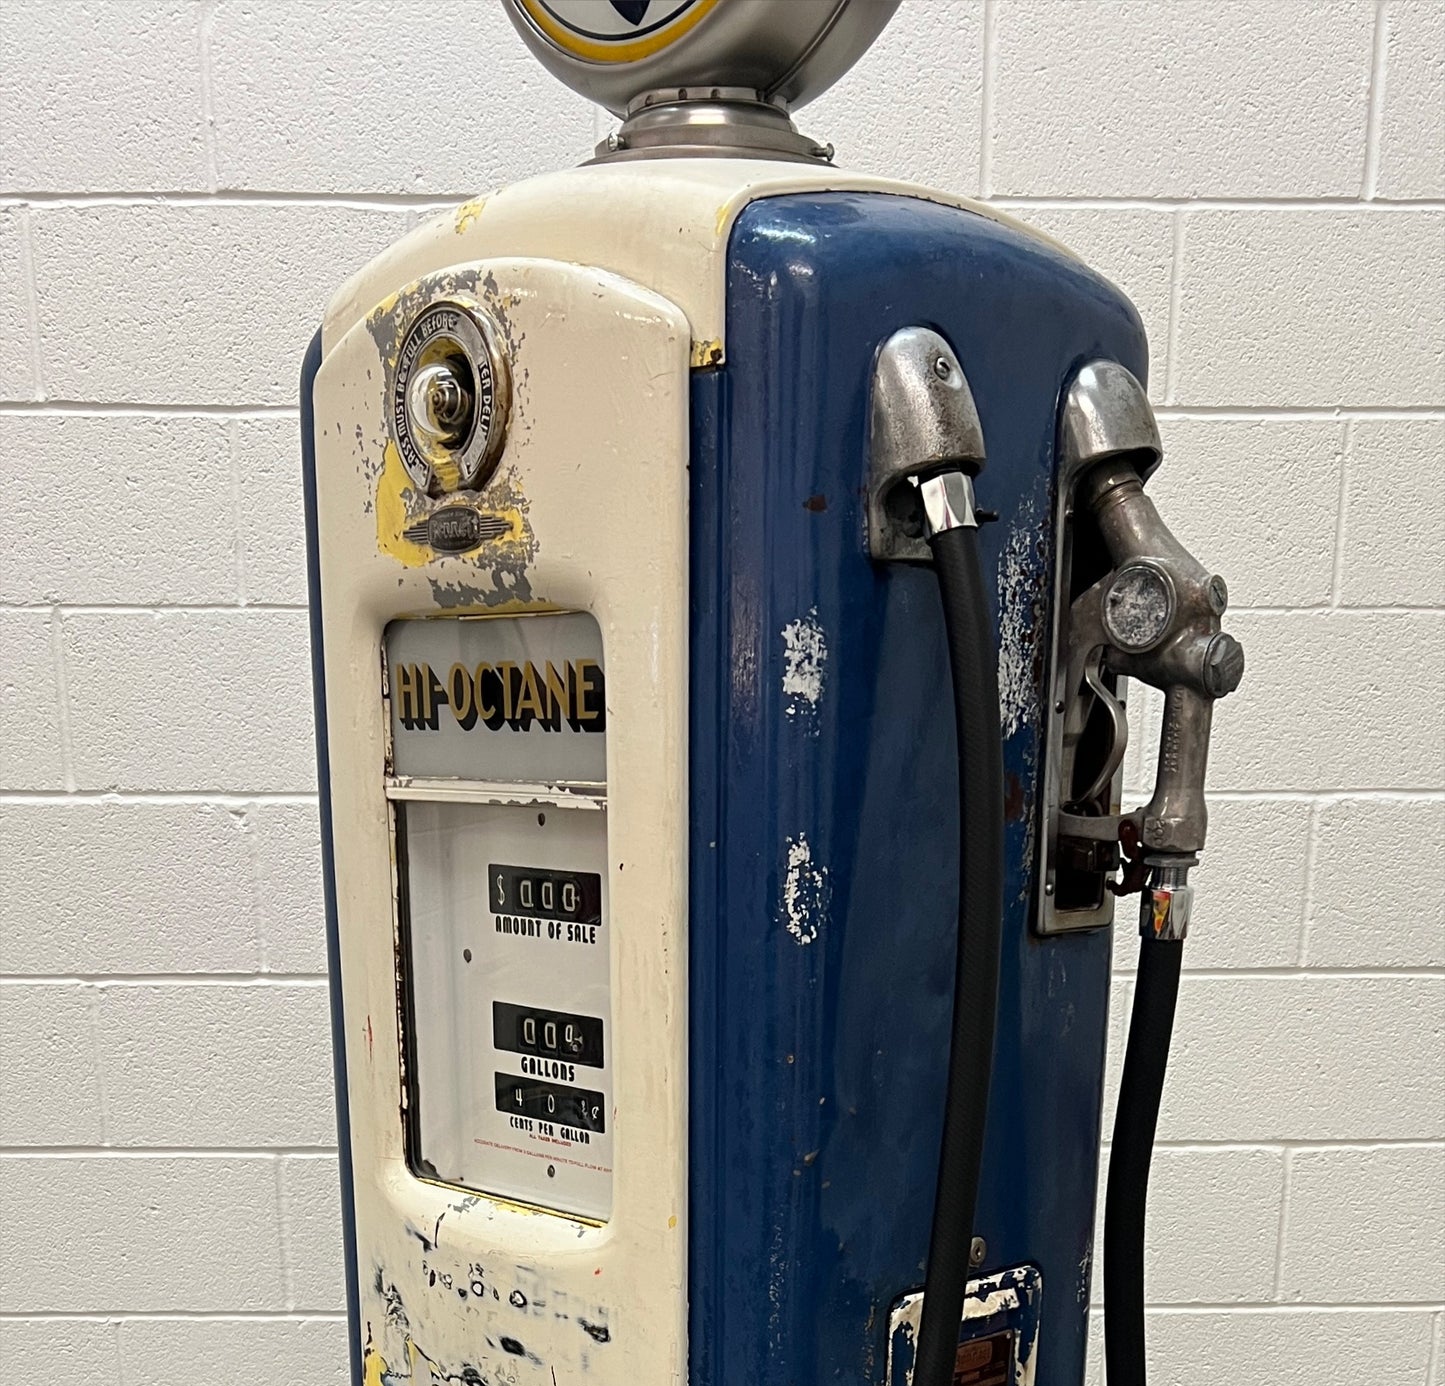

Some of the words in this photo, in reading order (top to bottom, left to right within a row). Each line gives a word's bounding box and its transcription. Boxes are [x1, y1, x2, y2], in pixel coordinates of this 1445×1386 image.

[396, 395, 407, 436] MUST
[403, 333, 421, 365] FULL
[396, 658, 606, 732] HI-OCTANE
[495, 915, 541, 938] AMOUNT
[548, 921, 561, 940] OF
[567, 924, 596, 944] SALE
[521, 1056, 575, 1082] GALLONS
[509, 1115, 533, 1132] CENTS
[538, 1121, 554, 1137] PER
[560, 1126, 590, 1145] GALLON
